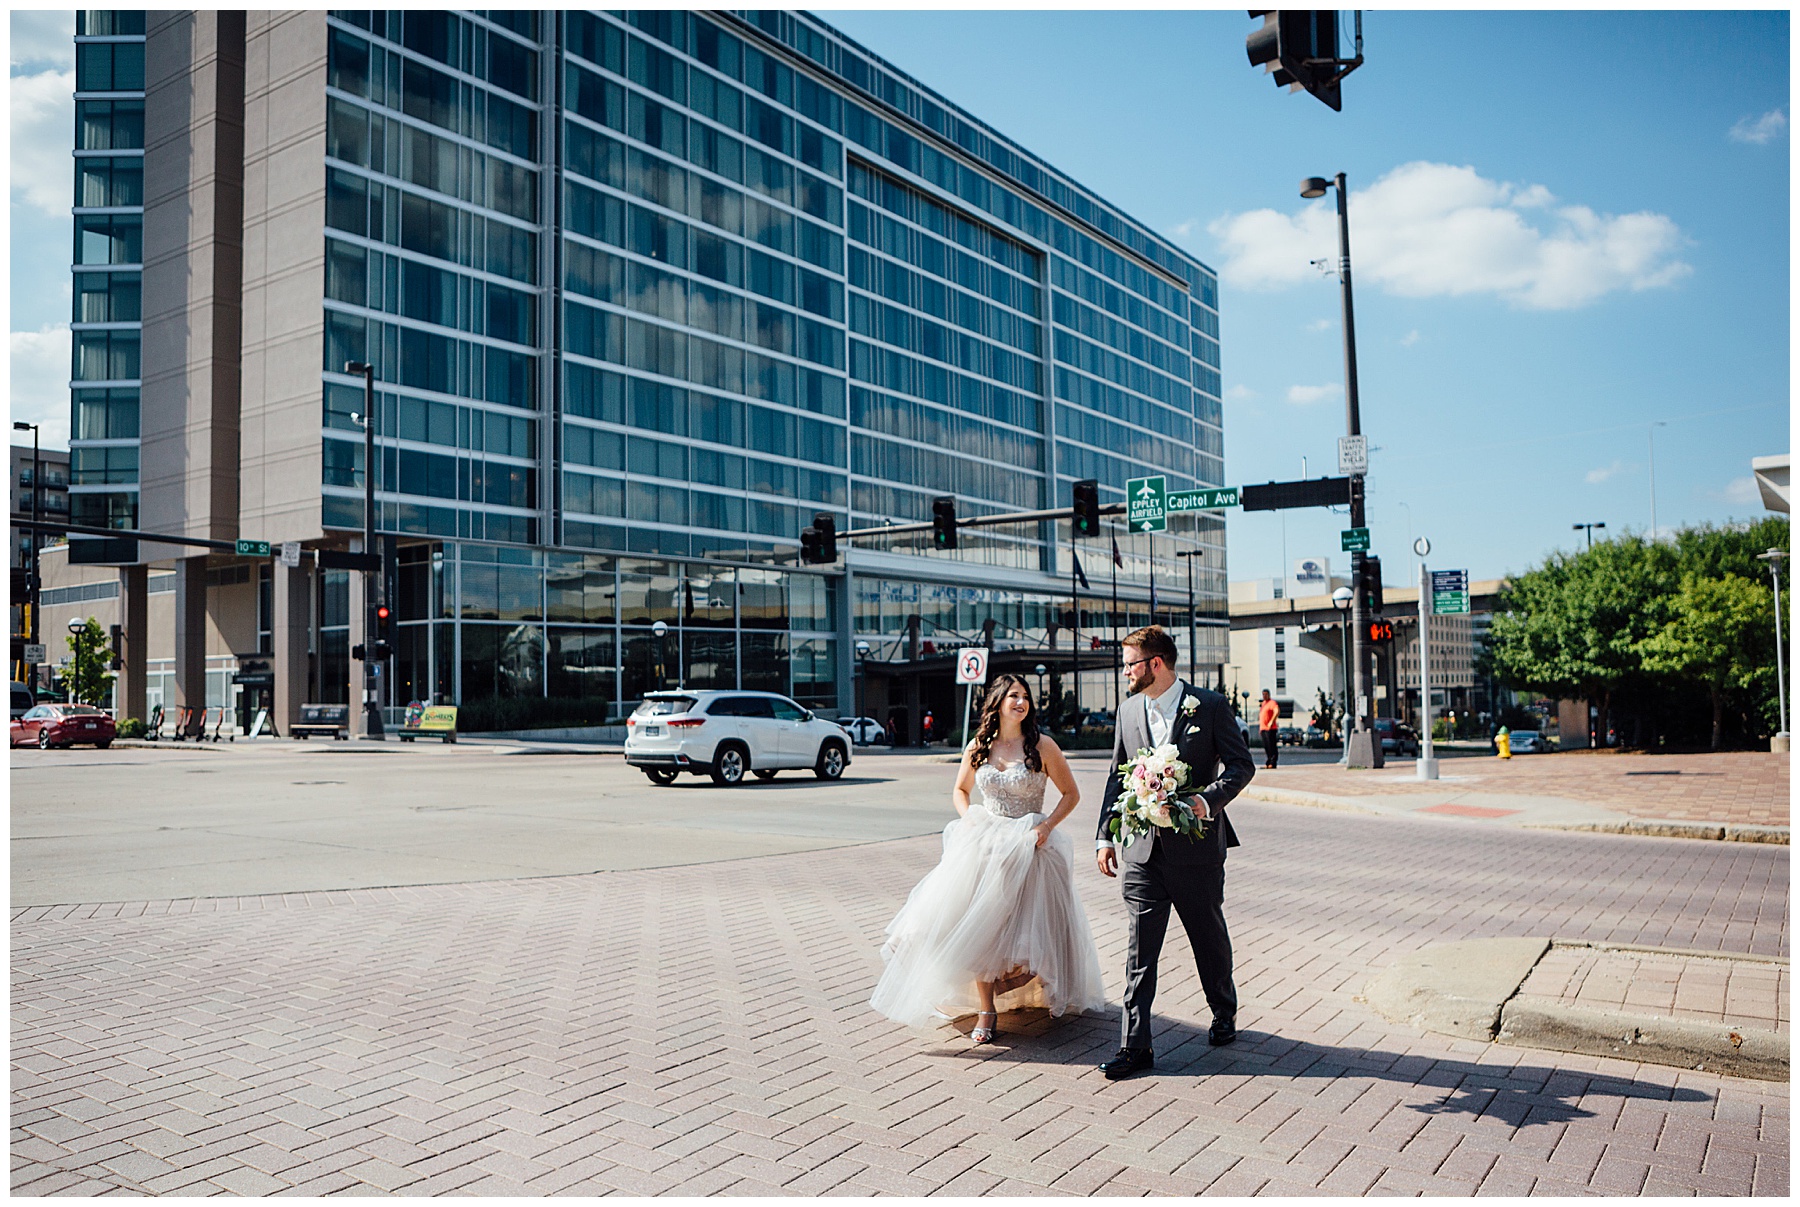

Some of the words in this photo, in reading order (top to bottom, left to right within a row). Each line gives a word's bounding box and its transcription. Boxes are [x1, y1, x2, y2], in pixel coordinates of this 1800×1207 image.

[1132, 498, 1160, 510] EPPLEY
[1168, 494, 1207, 510] Capitol
[1214, 492, 1236, 504] Ave
[1130, 508, 1162, 518] AIRFIELD
[260, 544, 268, 552] St
[1380, 624, 1392, 639] 15
